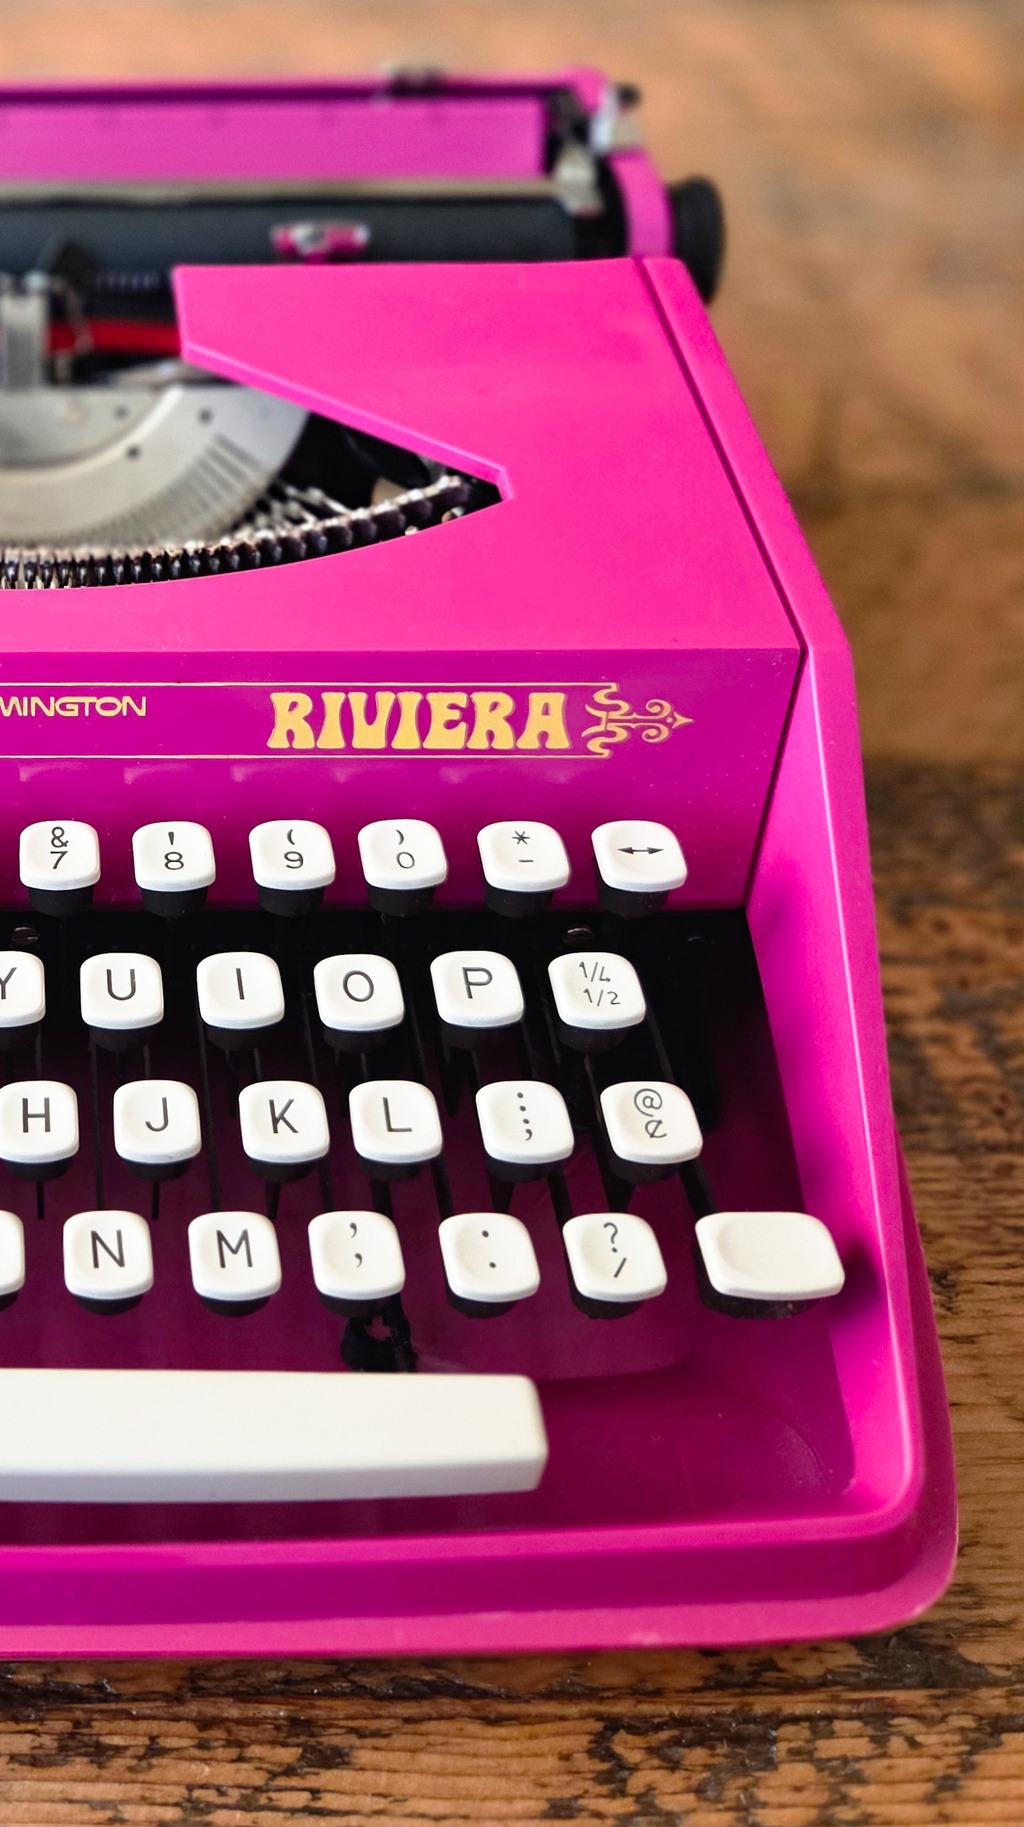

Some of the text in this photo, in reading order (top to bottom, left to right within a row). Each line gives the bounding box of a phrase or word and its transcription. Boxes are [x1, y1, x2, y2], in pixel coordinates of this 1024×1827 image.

[267, 691, 570, 751] RIVIERA
[49, 825, 70, 850] &
[49, 850, 69, 870] 7
[164, 851, 185, 871] 8
[283, 851, 304, 870] 9
[106, 968, 137, 1001] U
[235, 967, 245, 1001] I
[342, 970, 375, 1003] O
[462, 966, 493, 1000] P
[582, 987, 622, 1007] 1/2
[22, 1097, 51, 1134] H
[145, 1097, 169, 1132] J
[268, 1099, 299, 1134] K
[382, 1097, 413, 1133] L
[633, 1088, 663, 1118] @
[90, 1229, 125, 1269] N
[216, 1229, 253, 1269] M
[602, 1221, 619, 1254] ?
